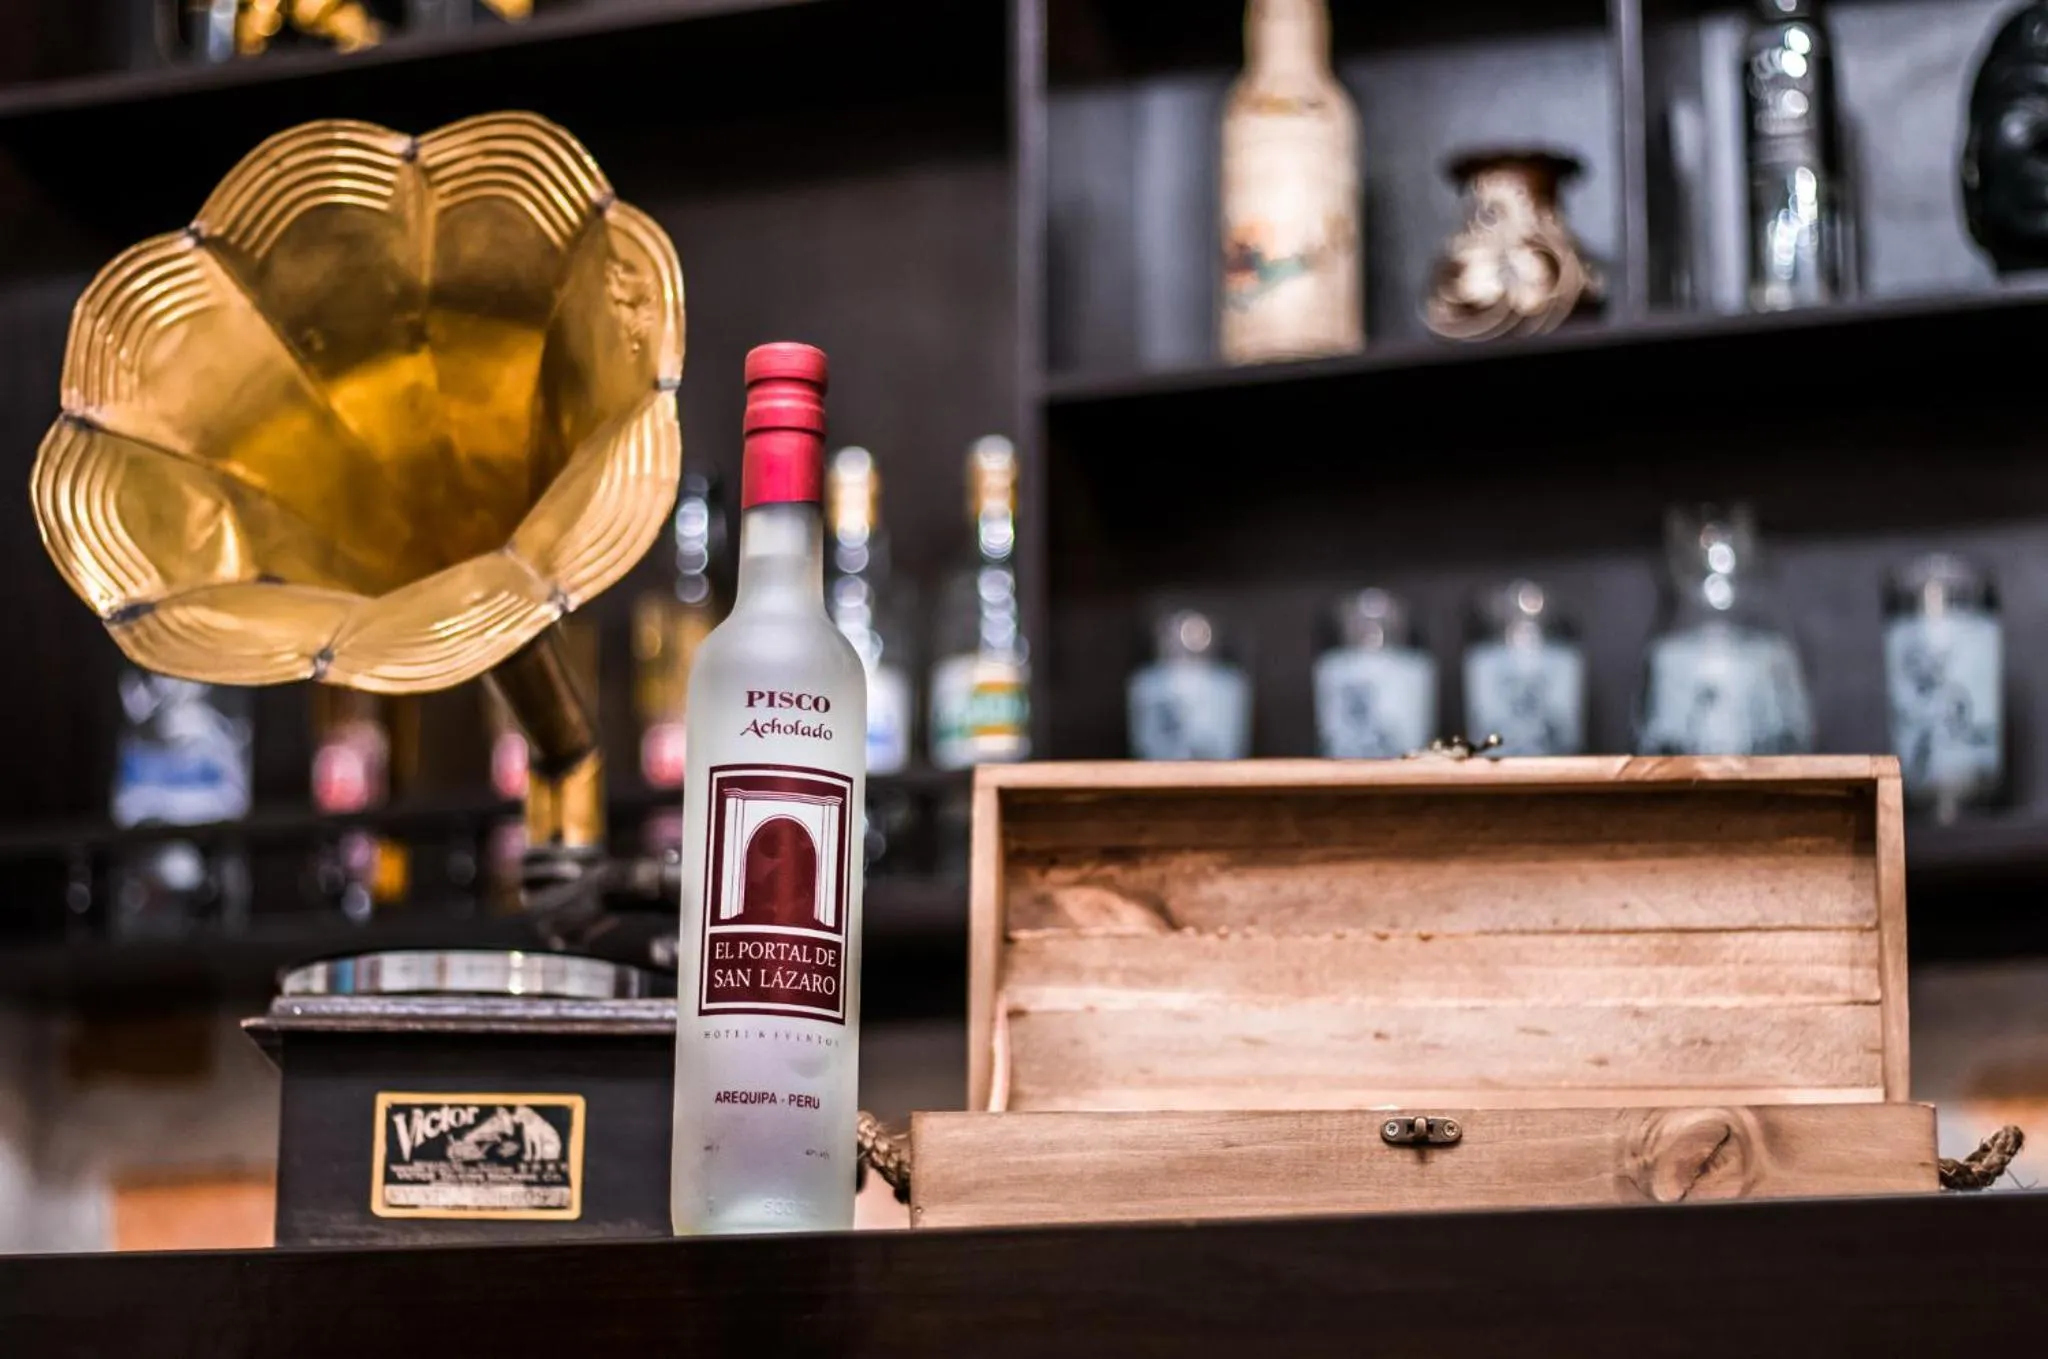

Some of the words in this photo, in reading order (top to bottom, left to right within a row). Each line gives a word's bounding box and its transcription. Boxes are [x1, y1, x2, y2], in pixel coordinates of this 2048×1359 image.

[745, 690, 831, 714] PISCO
[740, 718, 833, 741] Acholado
[715, 941, 734, 960] EL
[738, 941, 812, 964] PORTAL
[815, 946, 837, 968] DE
[713, 968, 752, 989] SAN
[760, 966, 836, 995] LÁZARO
[714, 1090, 778, 1105] AREQUIPA
[788, 1093, 820, 1109] PERU
[393, 1105, 480, 1162] Victor
